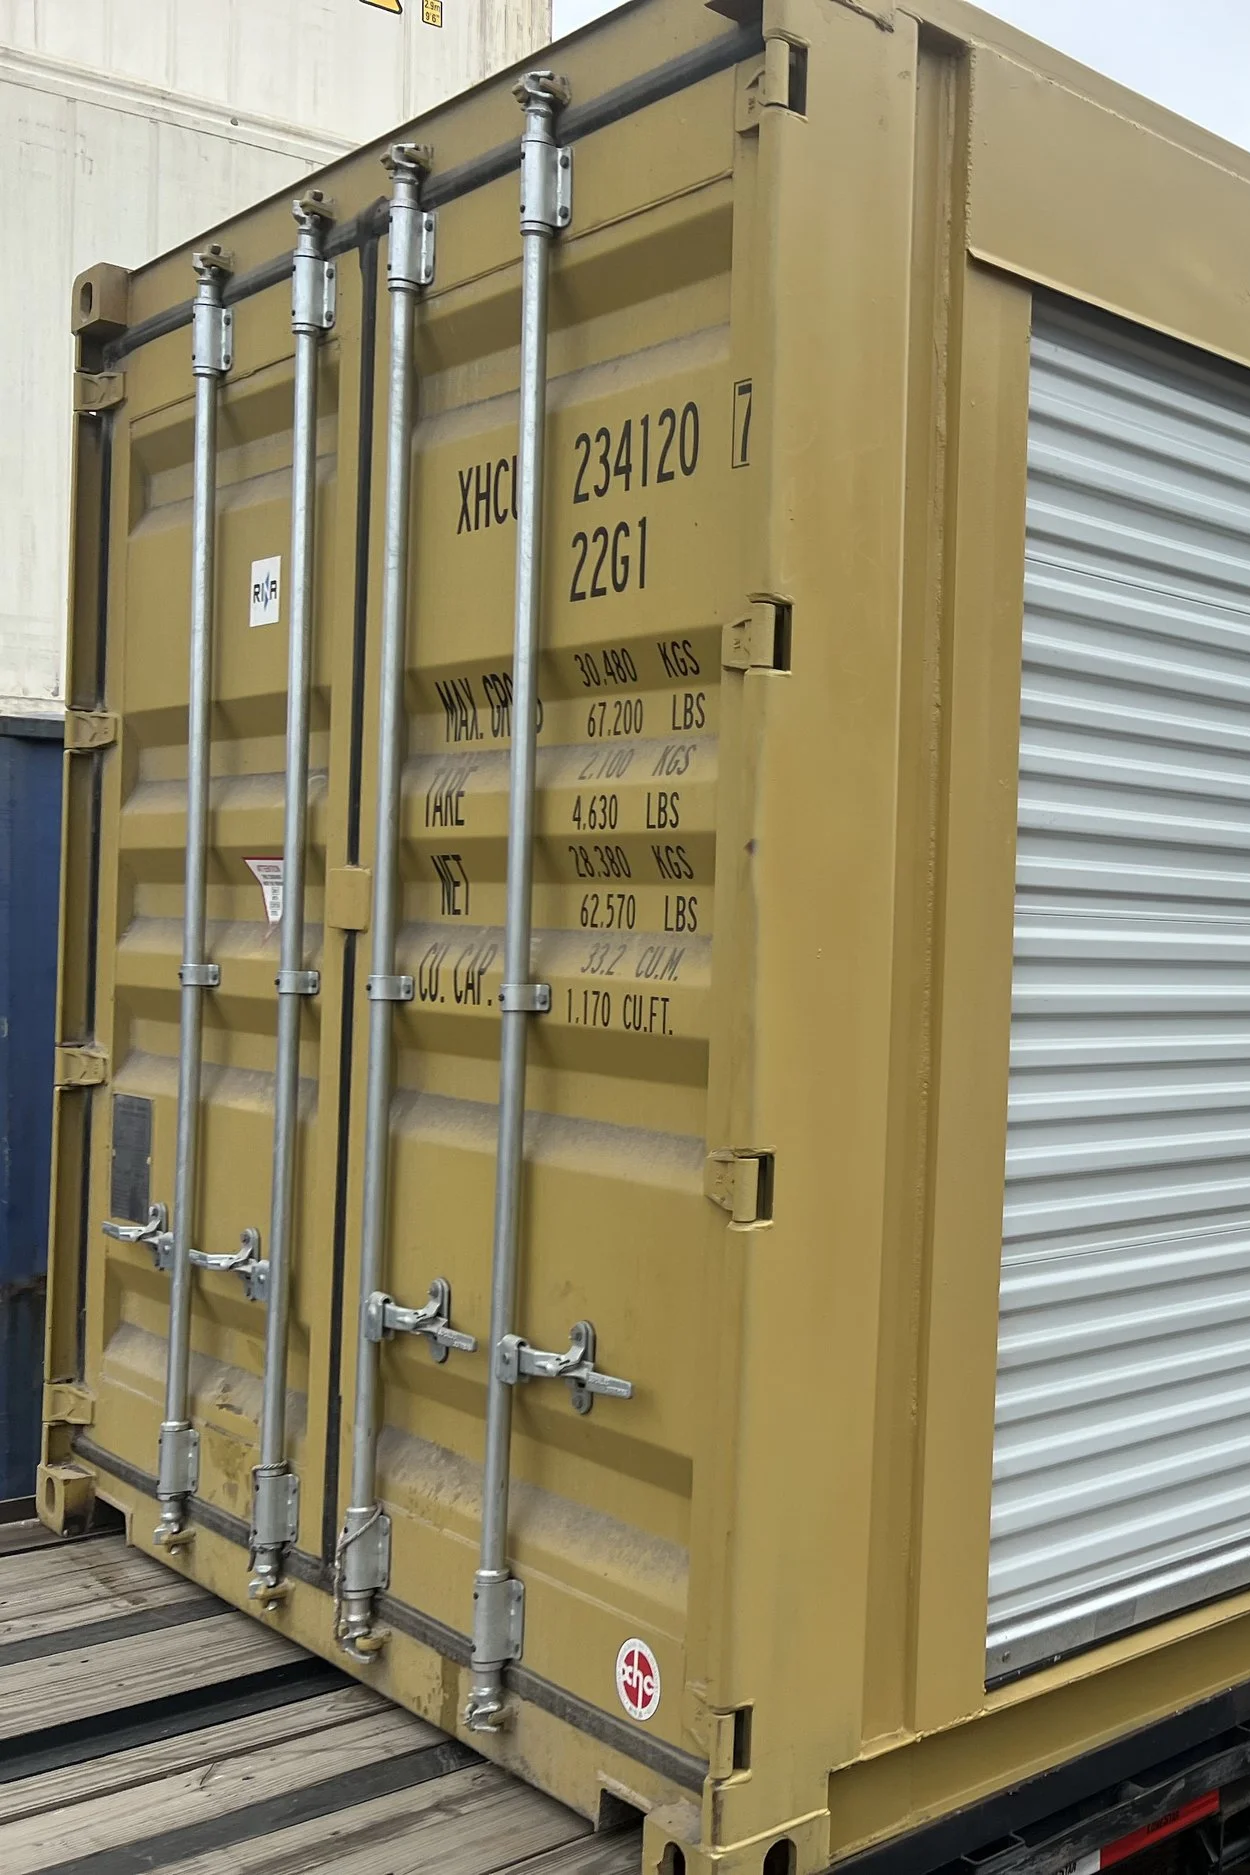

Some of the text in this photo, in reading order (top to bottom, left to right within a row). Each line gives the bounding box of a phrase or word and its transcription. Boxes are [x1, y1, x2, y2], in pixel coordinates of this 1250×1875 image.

[573, 401, 700, 504] 234120
[737, 383, 752, 462] 7
[569, 516, 647, 602] 22G1
[435, 677, 484, 742] MAX.
[574, 648, 638, 688] 30.480
[657, 640, 700, 679] KGS
[587, 698, 643, 738] 67.200
[671, 693, 706, 731] LBS
[425, 745, 697, 827] TARE 2.100 KGS
[572, 792, 680, 830] 4.630 LBS
[430, 845, 694, 916] NET 28.380 KGS
[580, 894, 698, 932] 62.570 LBS
[580, 944, 627, 976] 33.2
[566, 989, 611, 1027] 1.170
